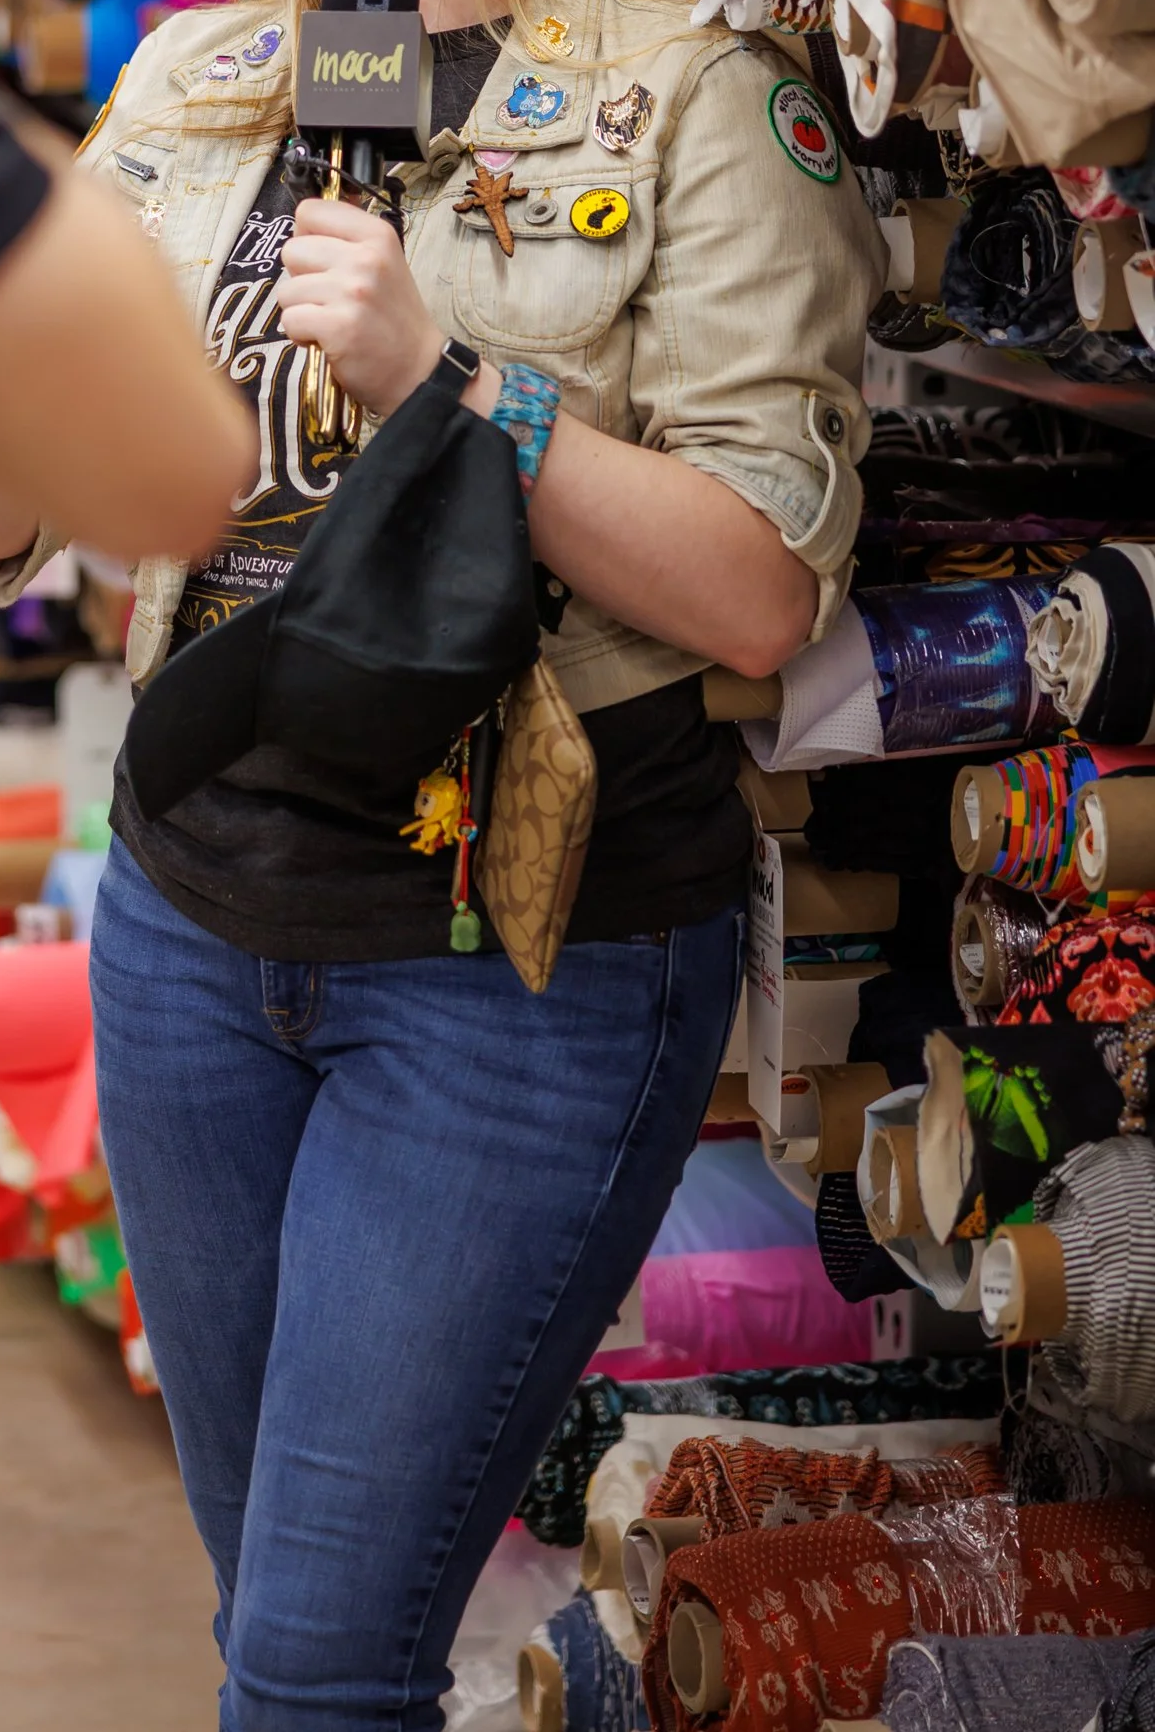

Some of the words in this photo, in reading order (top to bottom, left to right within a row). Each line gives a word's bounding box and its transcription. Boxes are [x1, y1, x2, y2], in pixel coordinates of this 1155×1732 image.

[312, 43, 405, 85] mood
[779, 88, 801, 114] stitch
[791, 141, 823, 173] worry
[583, 227, 611, 236] CHICKEN
[214, 553, 225, 569] OF
[200, 569, 218, 582] AND
[245, 576, 270, 589] THINGS.
